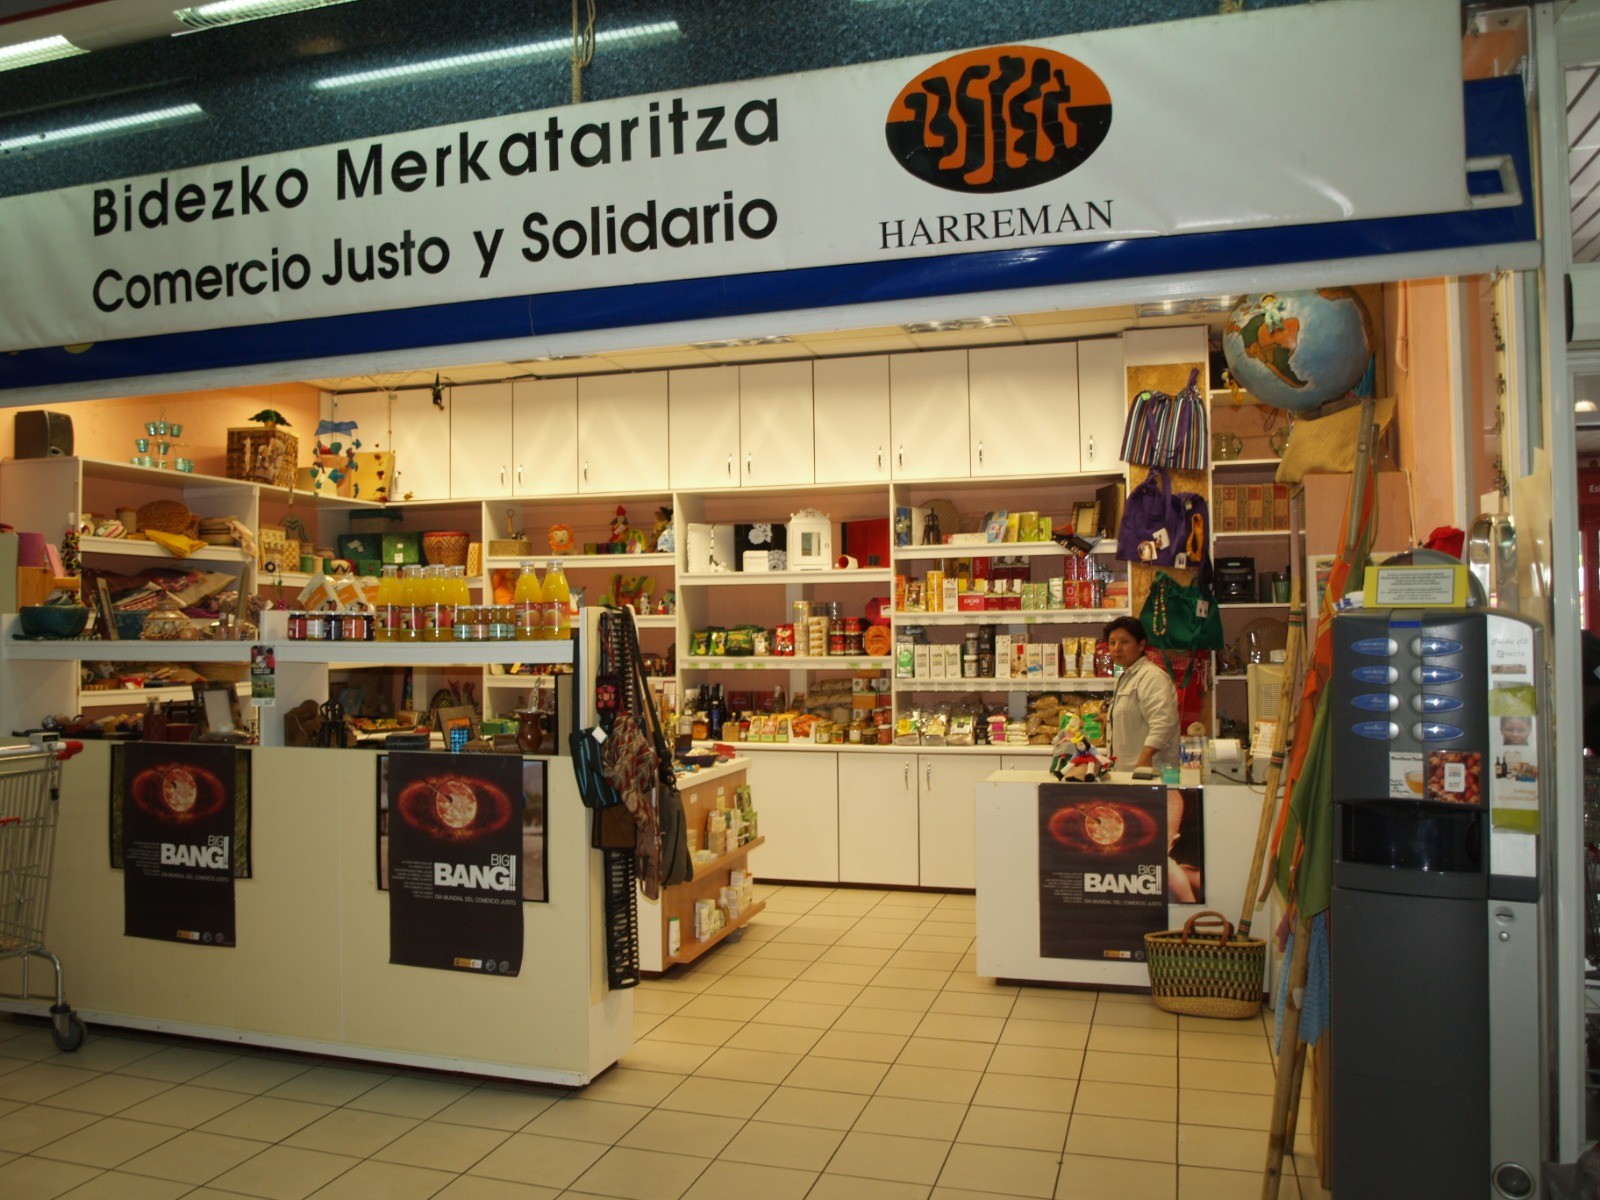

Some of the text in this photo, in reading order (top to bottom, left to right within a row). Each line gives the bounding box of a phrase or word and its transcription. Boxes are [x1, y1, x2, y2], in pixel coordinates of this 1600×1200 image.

[92, 97, 779, 237] Bidezko Merkataritza
[879, 200, 1114, 249] HARREMAN
[93, 190, 778, 313] Comercio Justo y Solidario
[208, 835, 224, 847] BIG
[490, 853, 510, 867] BIG
[1138, 864, 1156, 875] BIG
